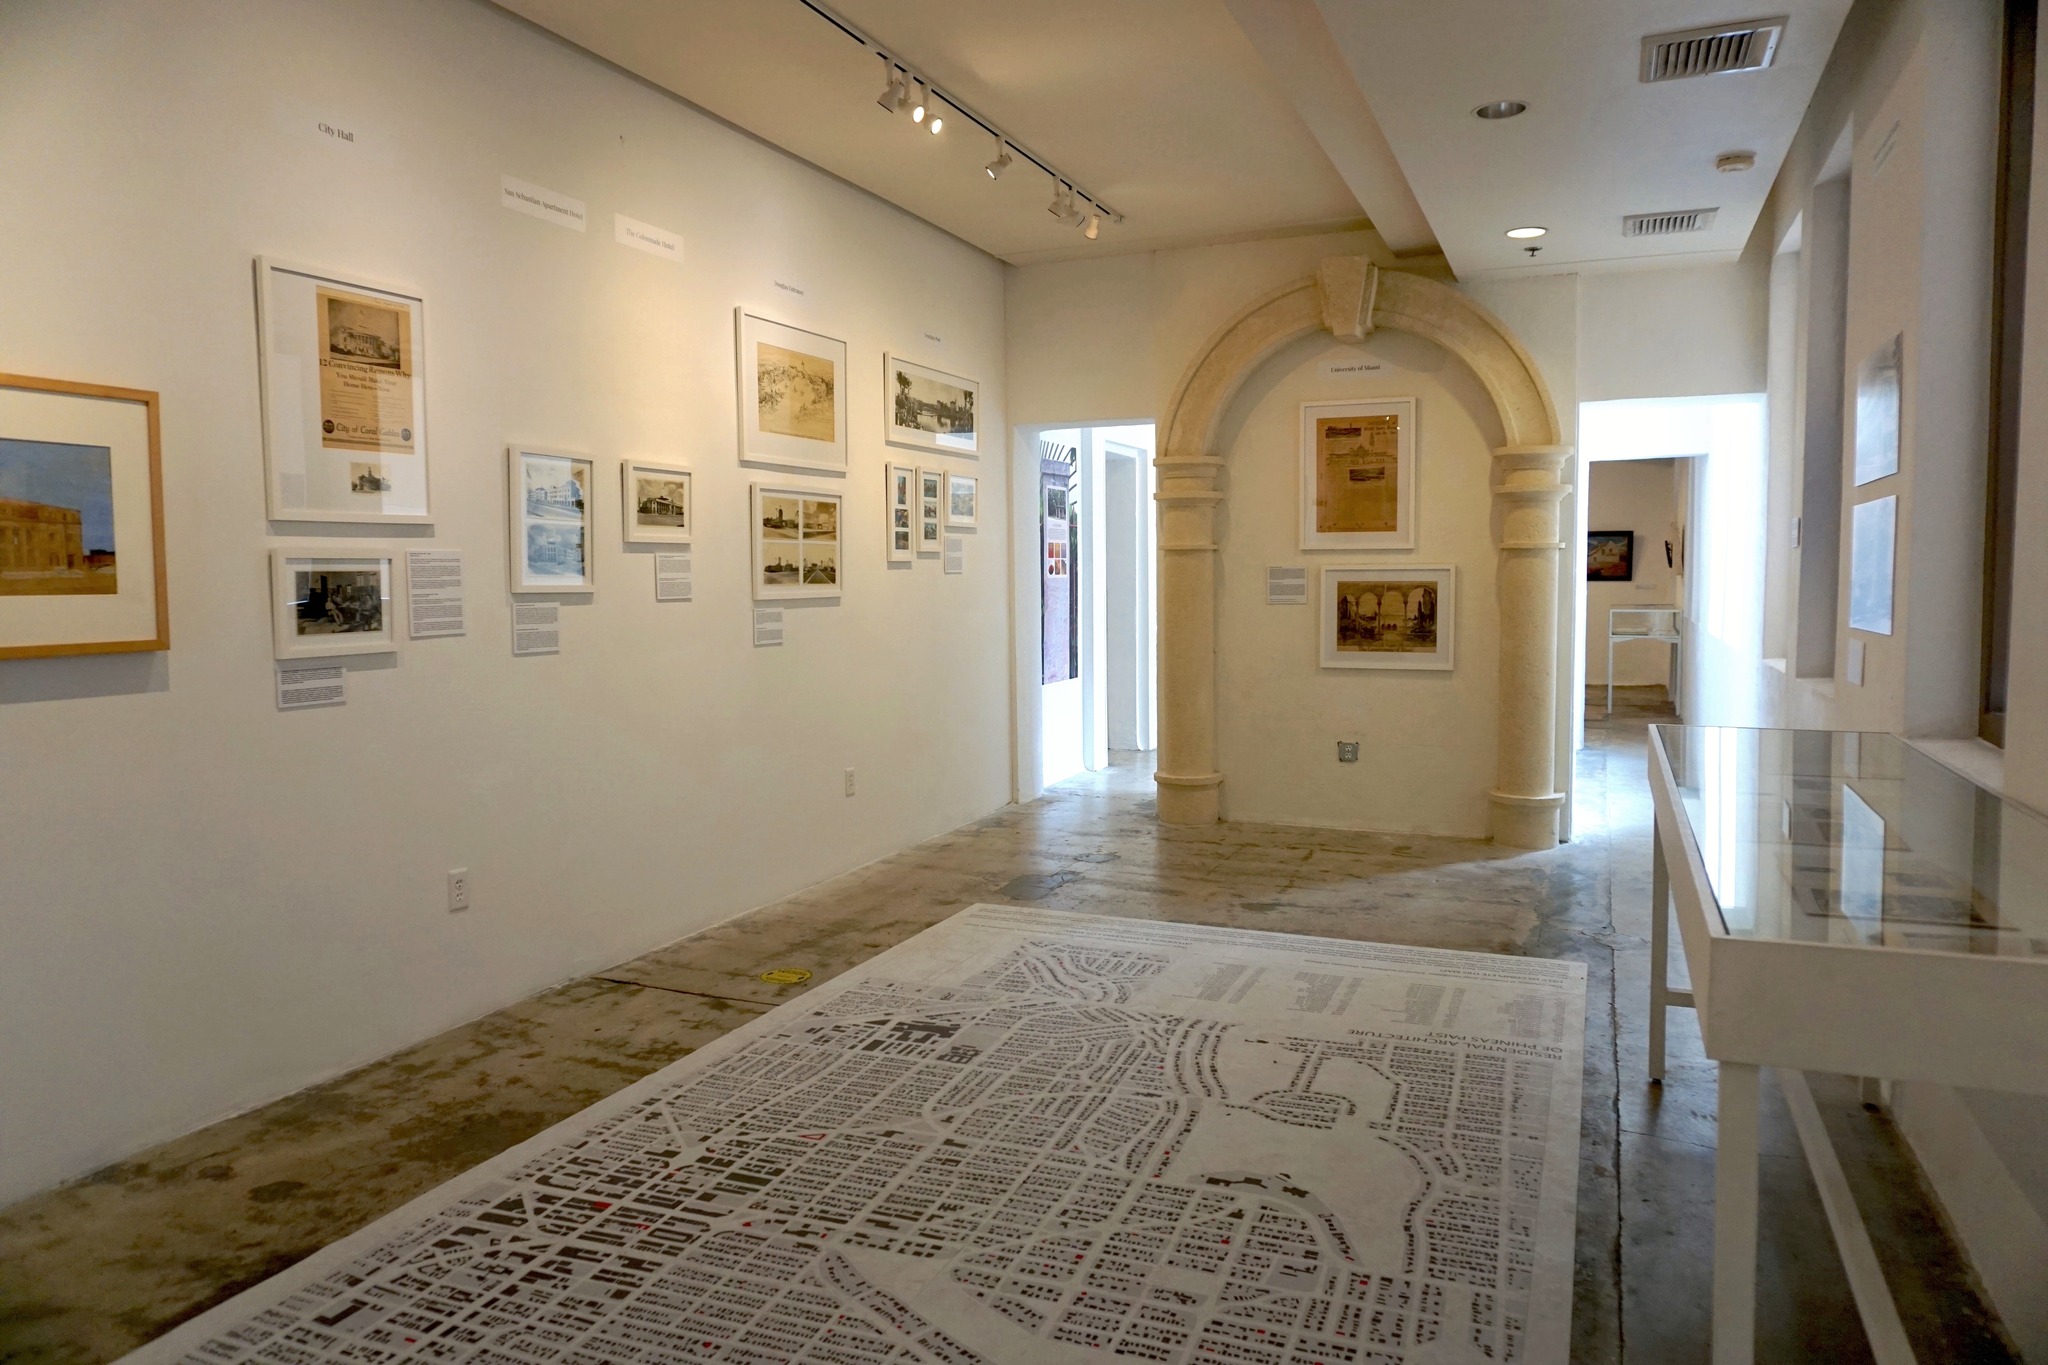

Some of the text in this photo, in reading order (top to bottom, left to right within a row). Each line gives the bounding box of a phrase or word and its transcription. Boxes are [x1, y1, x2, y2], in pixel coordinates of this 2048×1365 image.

[318, 122, 354, 143] City Hall
[542, 200, 569, 215] Apartment
[625, 228, 635, 238] The
[661, 239, 674, 251] Hotel
[319, 358, 412, 379] 12 Convincing Reasons Why
[348, 373, 367, 382] Should
[336, 422, 350, 434] City
[351, 425, 358, 433] of
[360, 425, 378, 435] Coral
[1346, 1029, 1562, 1060] RESIDENTIAL ARCHITECTURE
[1424, 1031, 1563, 1054] OF PHINEAS PAIST
